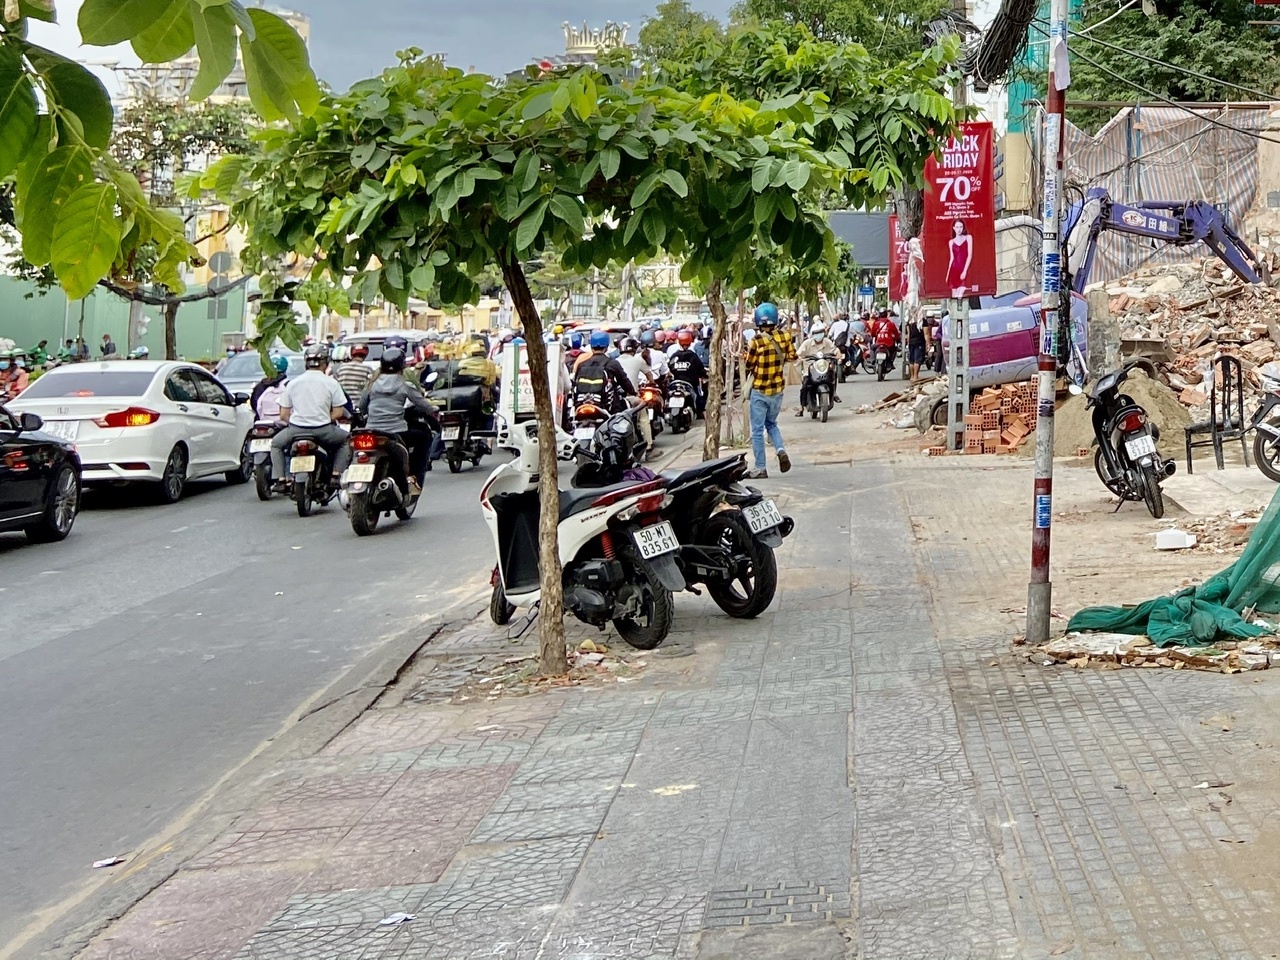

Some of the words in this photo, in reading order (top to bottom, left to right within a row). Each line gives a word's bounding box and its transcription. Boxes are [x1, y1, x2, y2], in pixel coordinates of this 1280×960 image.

[748, 502, 772, 519] 36-L6
[751, 513, 781, 531] 073.10
[640, 525, 666, 543] 50-N1
[642, 536, 676, 556] 835.61
